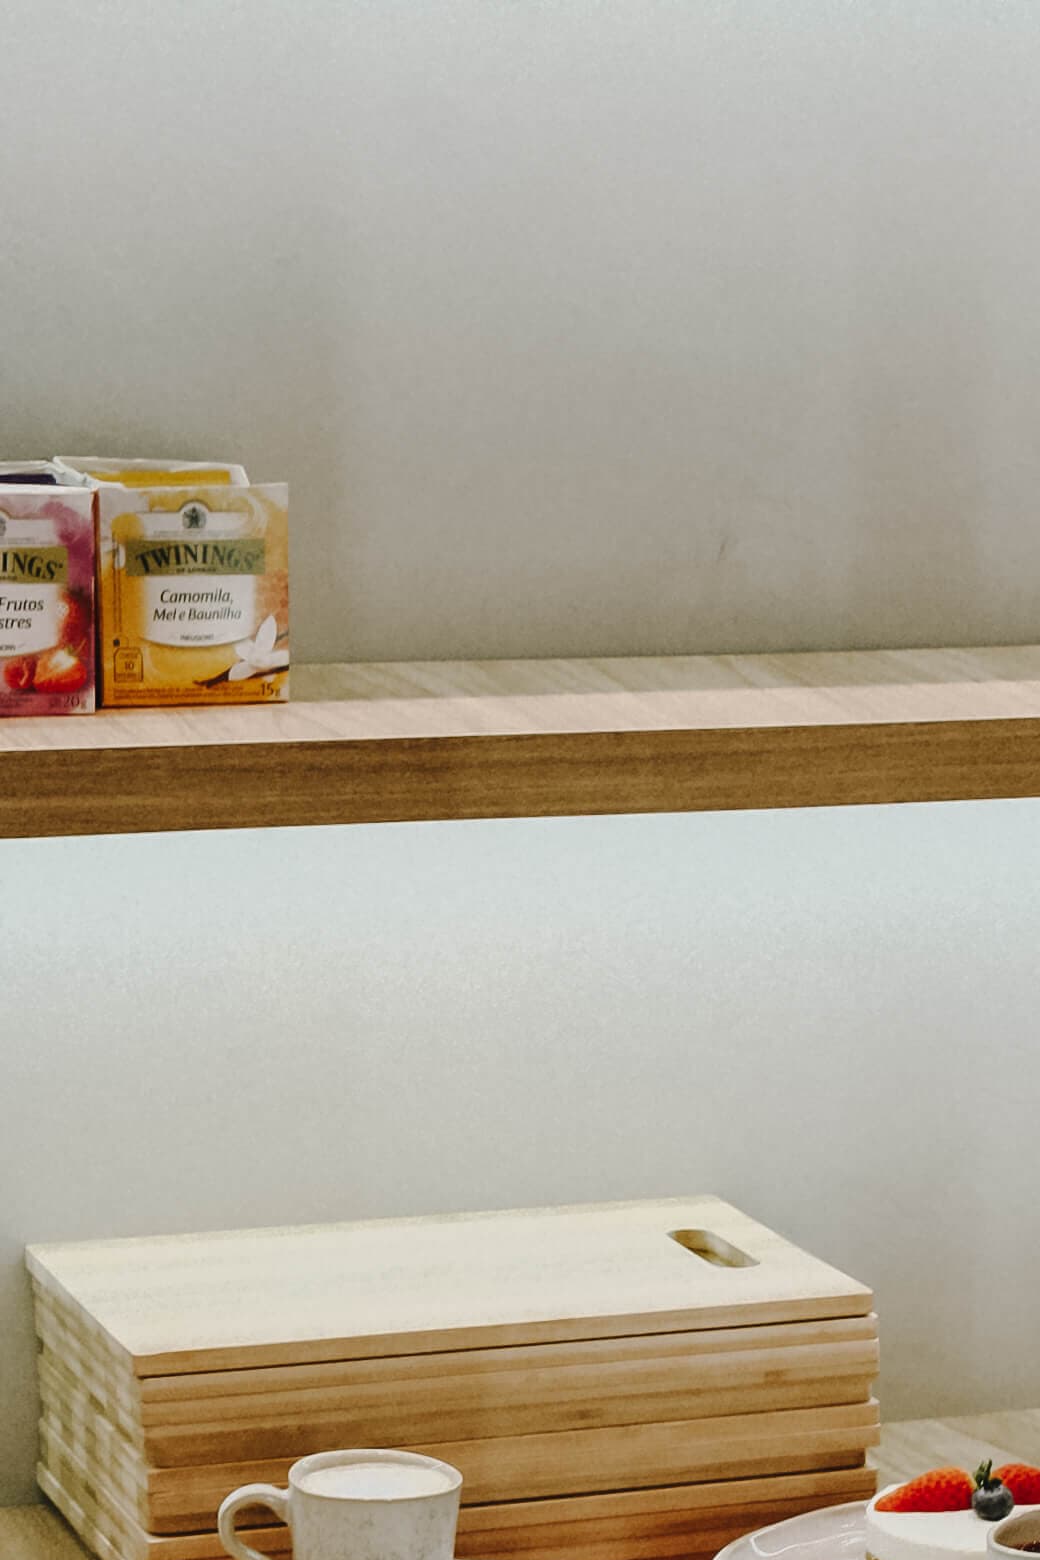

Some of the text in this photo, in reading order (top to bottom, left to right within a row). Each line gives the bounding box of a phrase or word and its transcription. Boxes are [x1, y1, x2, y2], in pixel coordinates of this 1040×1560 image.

[136, 543, 256, 574] TWININGS
[160, 588, 235, 605] Camomila,
[153, 607, 242, 622] Mel e Baunilha
